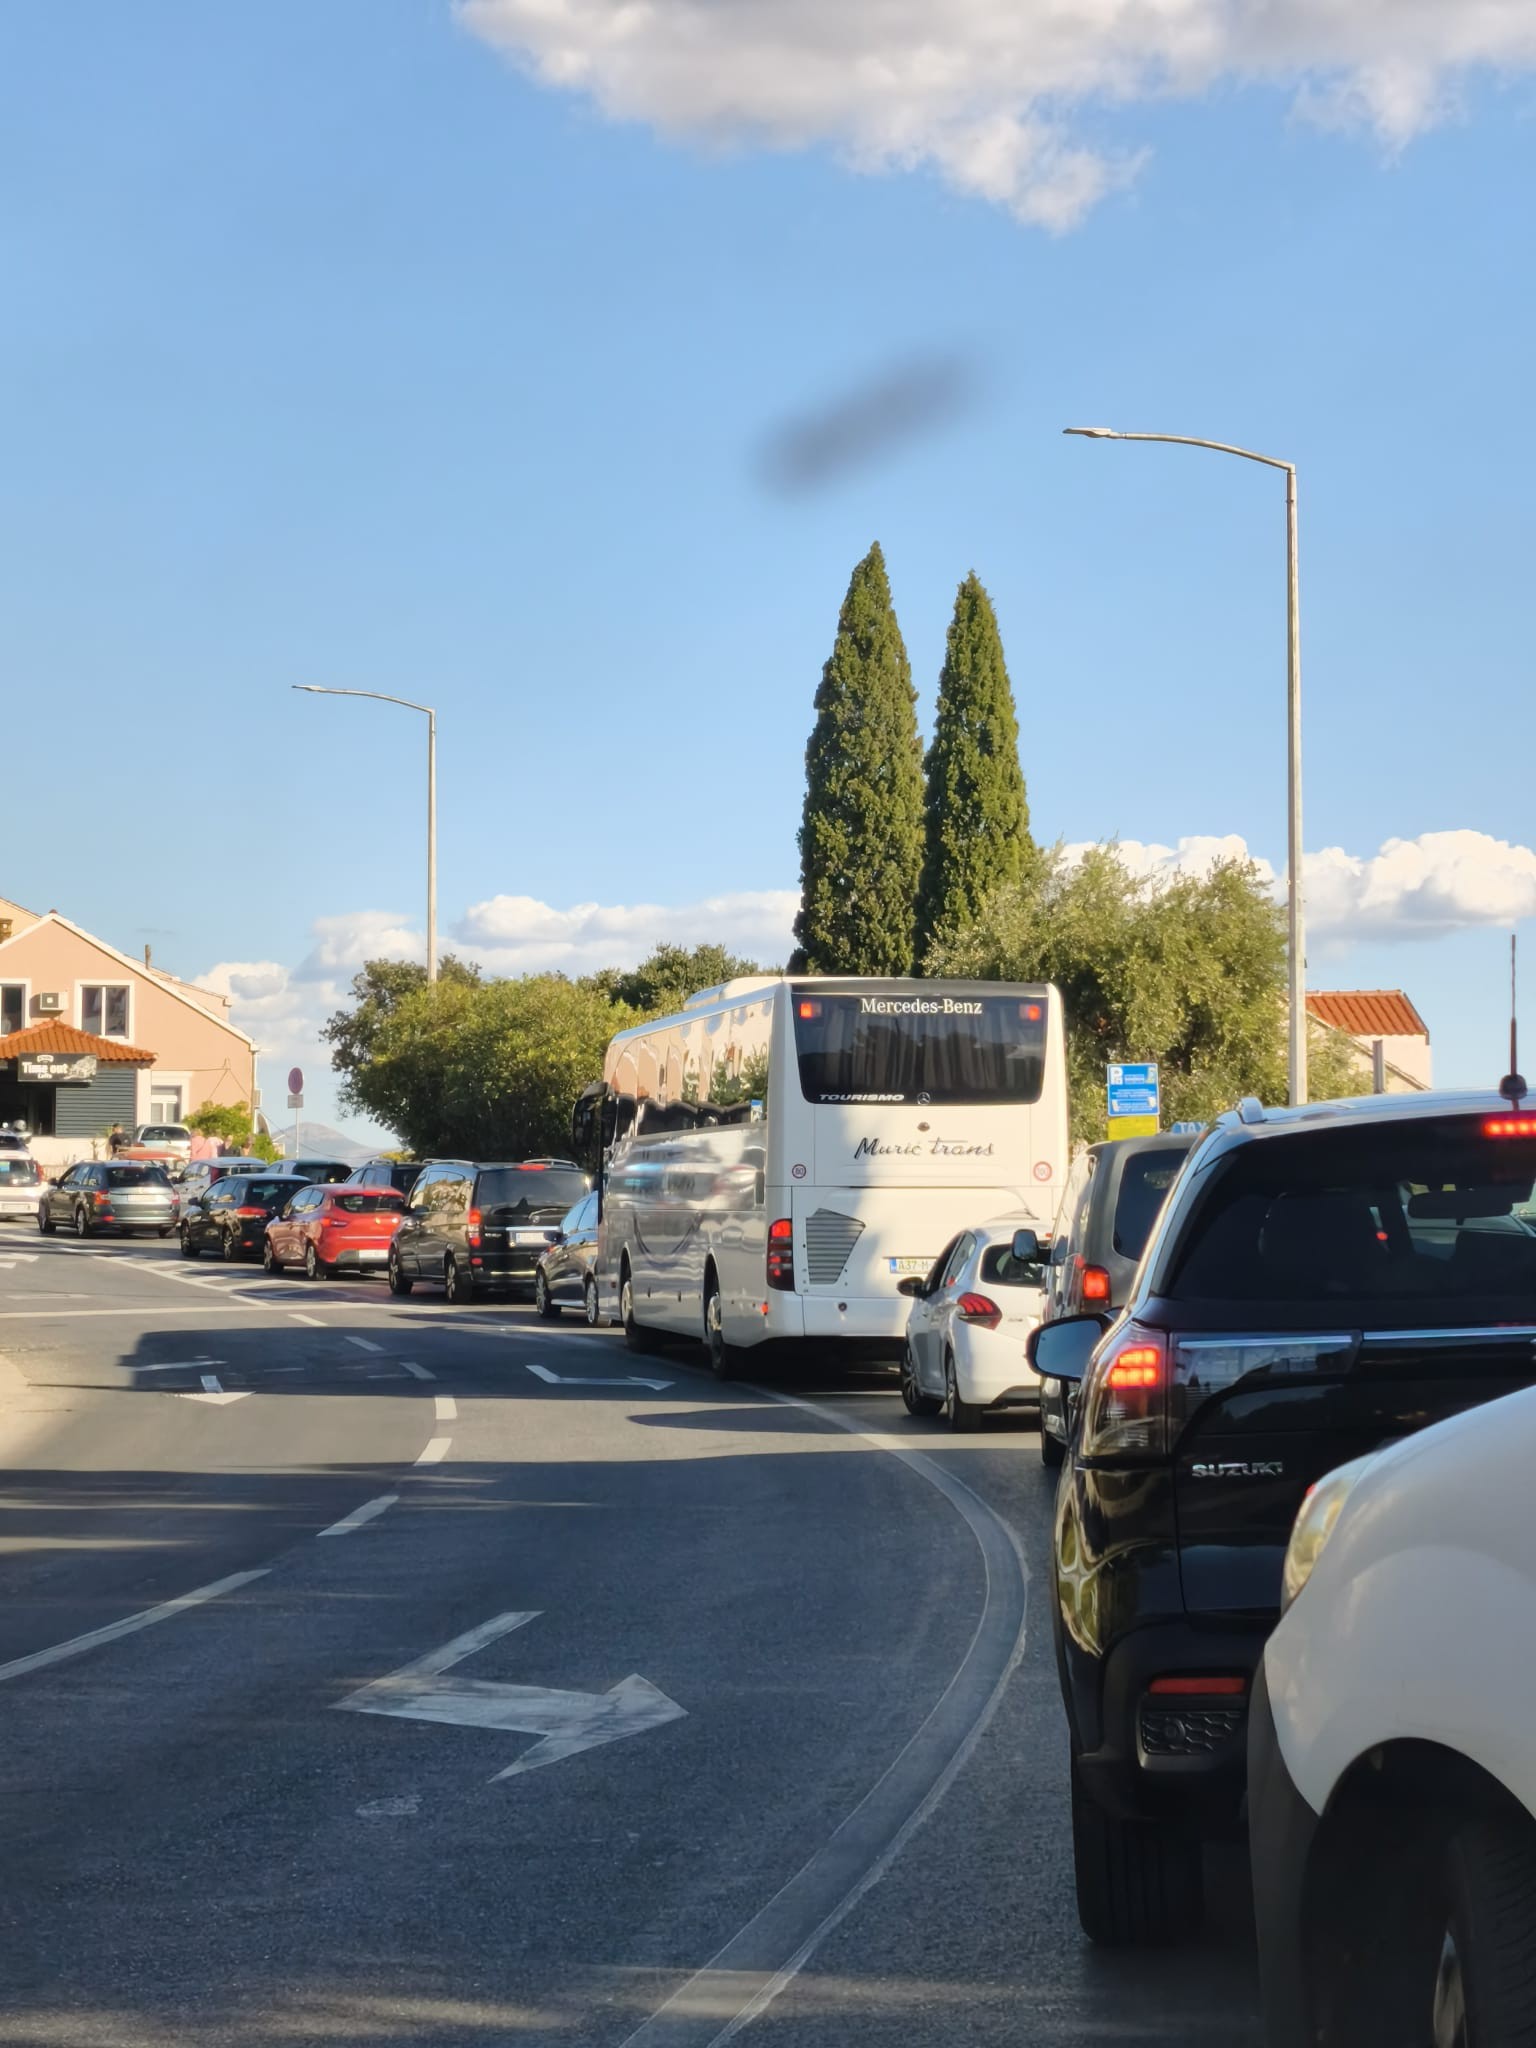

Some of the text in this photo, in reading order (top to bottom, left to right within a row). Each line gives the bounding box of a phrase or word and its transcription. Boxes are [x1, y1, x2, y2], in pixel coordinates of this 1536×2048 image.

[860, 998, 983, 1014] Mercedes-Benz
[22, 1061, 69, 1074] Time out
[820, 1093, 905, 1102] TOURISMO
[1180, 1121, 1207, 1134] TAX
[928, 1136, 992, 1157] trans
[1192, 1462, 1283, 1478] SUZUKI
